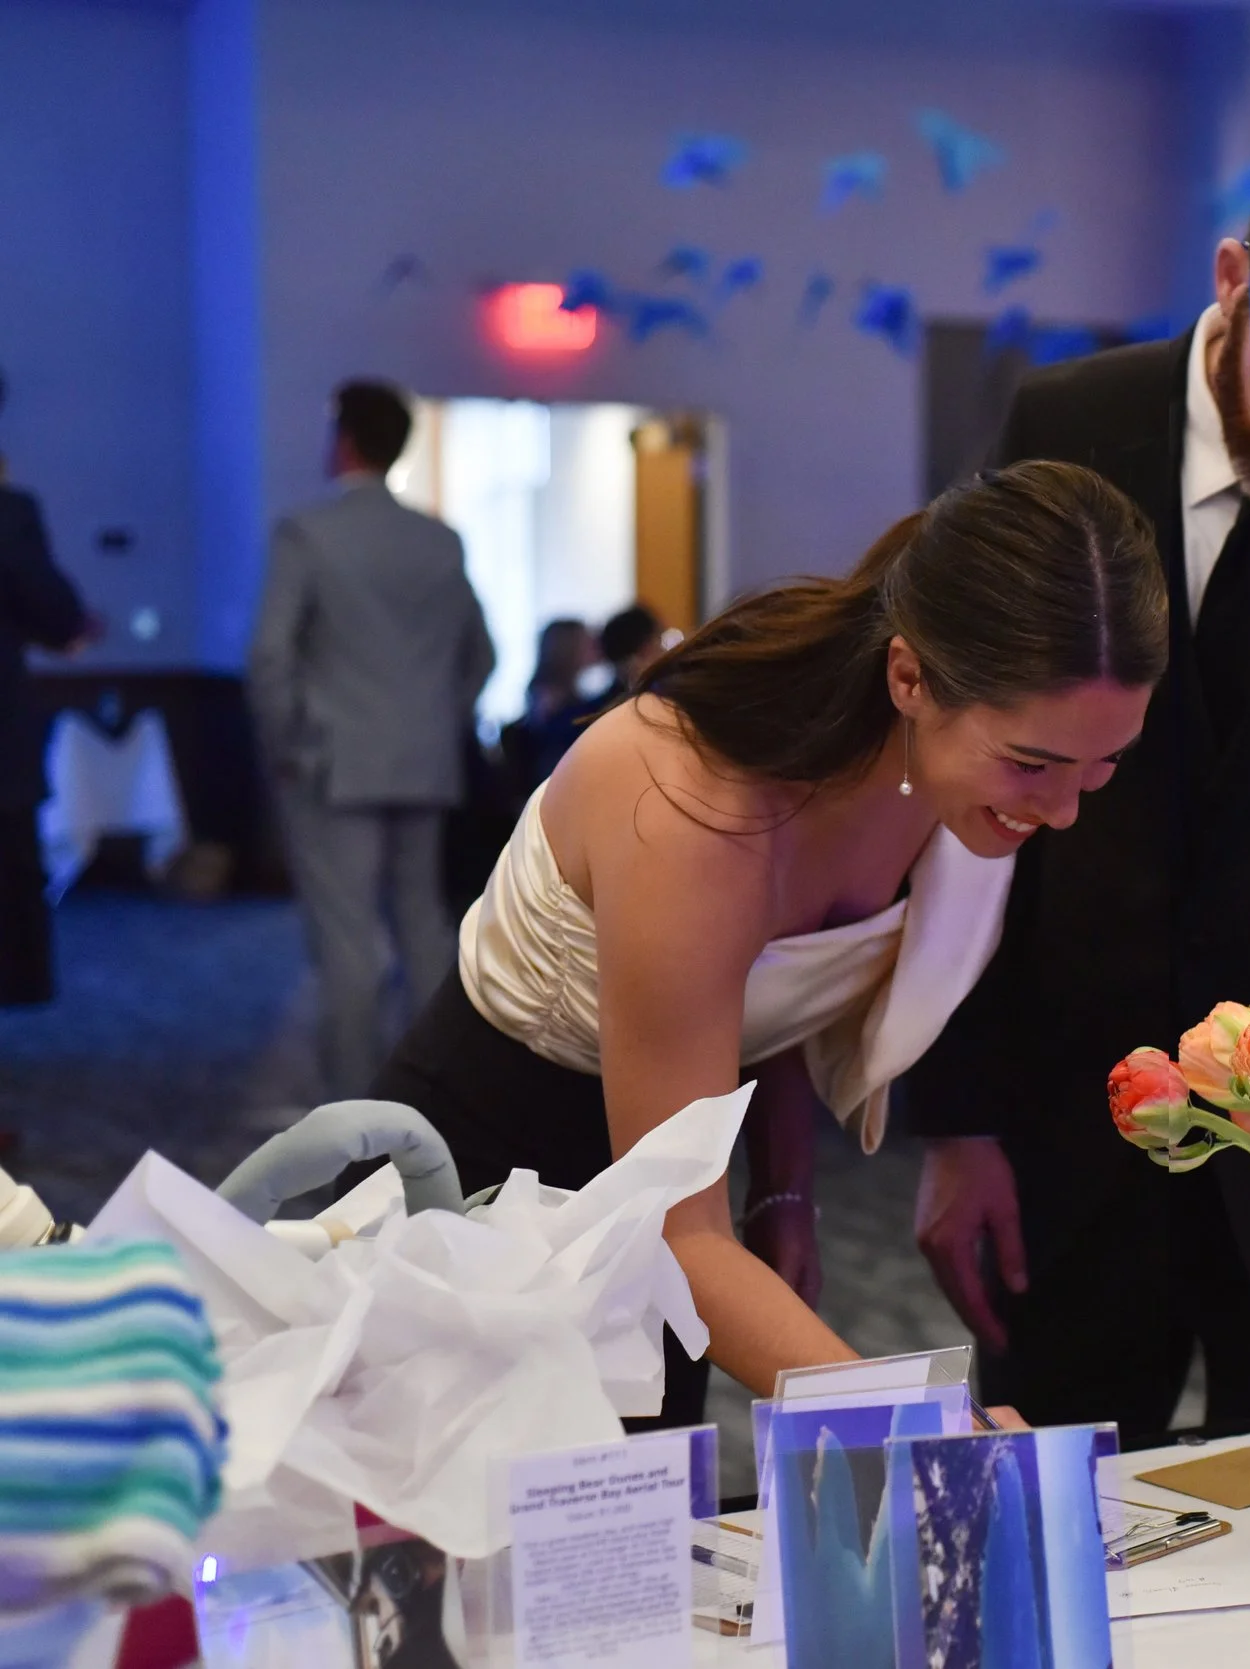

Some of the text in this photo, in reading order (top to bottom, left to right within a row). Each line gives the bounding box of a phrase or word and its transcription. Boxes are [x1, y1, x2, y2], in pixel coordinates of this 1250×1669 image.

[509, 1499, 545, 1515] Grand
[548, 1492, 598, 1508] Traverse
[600, 1488, 622, 1501] Bay
[661, 1476, 686, 1490] Tour
[526, 1466, 669, 1499] Sleeping Bear Dunes and
